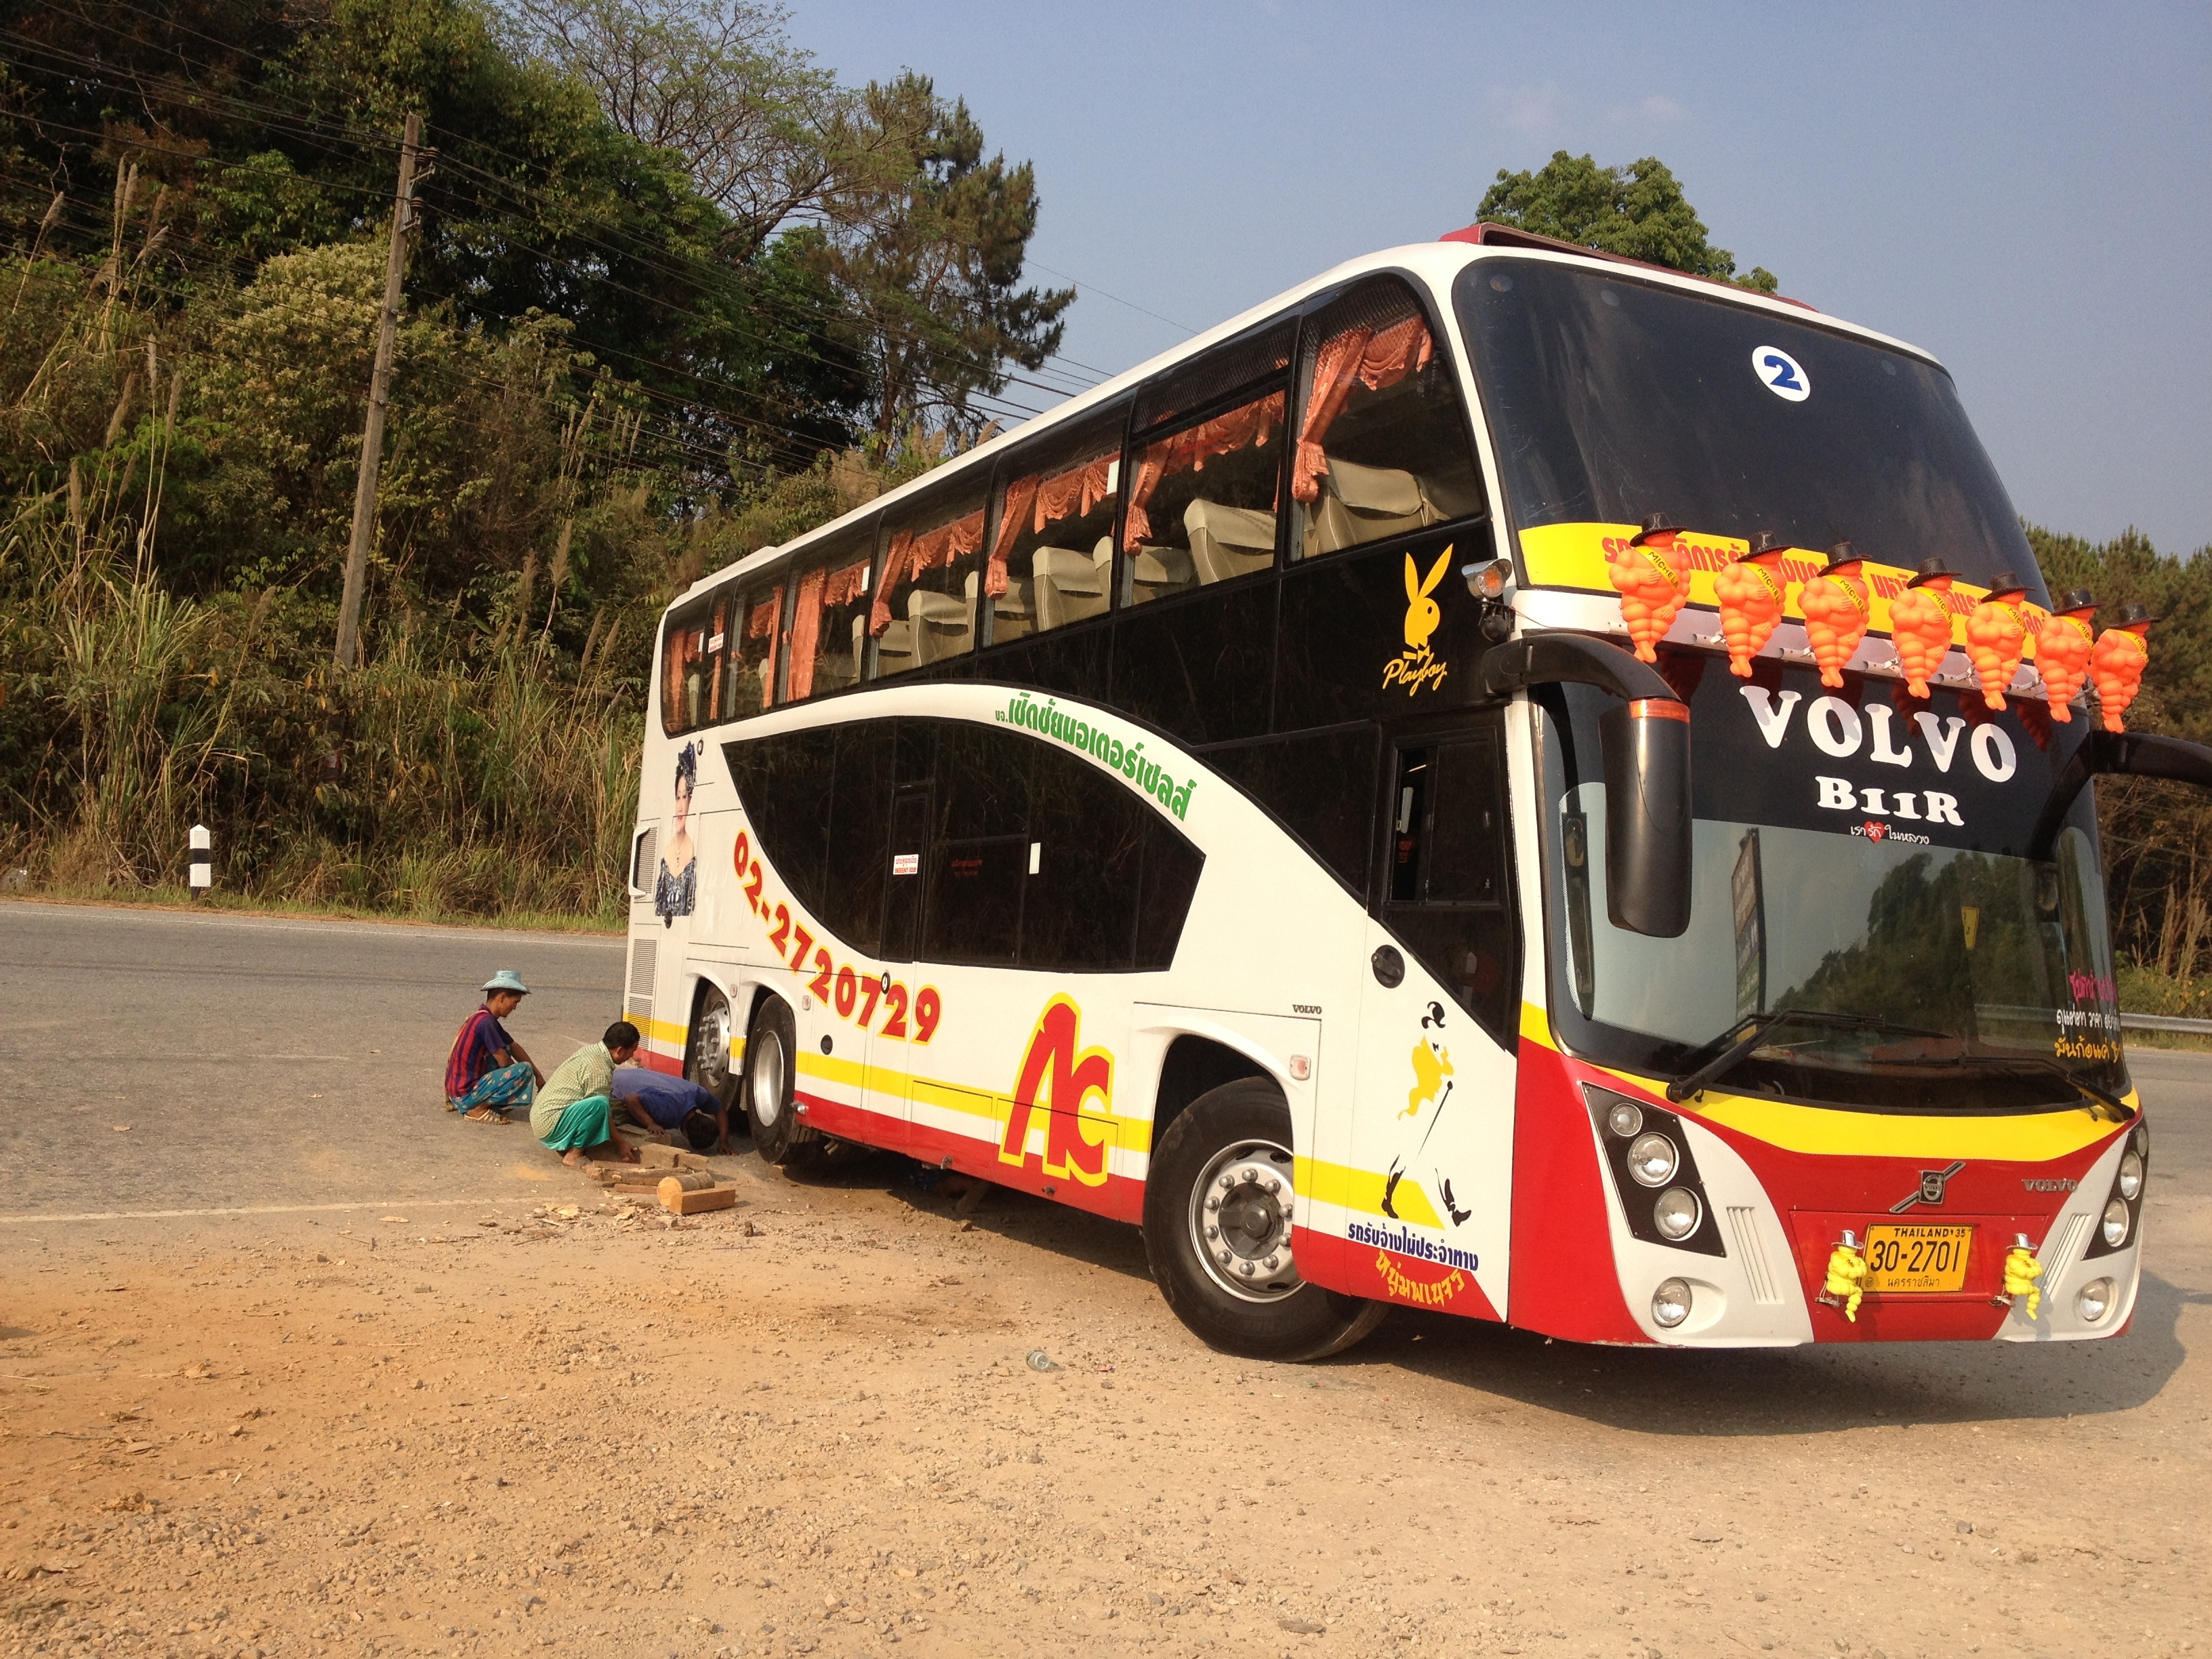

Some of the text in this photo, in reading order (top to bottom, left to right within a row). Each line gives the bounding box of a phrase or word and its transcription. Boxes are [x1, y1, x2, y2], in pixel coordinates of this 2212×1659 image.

[1763, 354, 1803, 392] 2
[1382, 652, 1448, 697] Playboy
[1739, 685, 2017, 783] VOLVO
[734, 829, 942, 1046] 02-2720729
[1292, 1004, 1323, 1015] VOLVO
[2021, 1178, 2078, 1192] VOLVO
[1348, 1222, 1479, 1271] รถรับจ้างไม่ประจำทาง
[1894, 1227, 1949, 1237] THAILAND
[1870, 1240, 1961, 1272] 30-2701
[1887, 1275, 1940, 1287] นครราชสีมา
